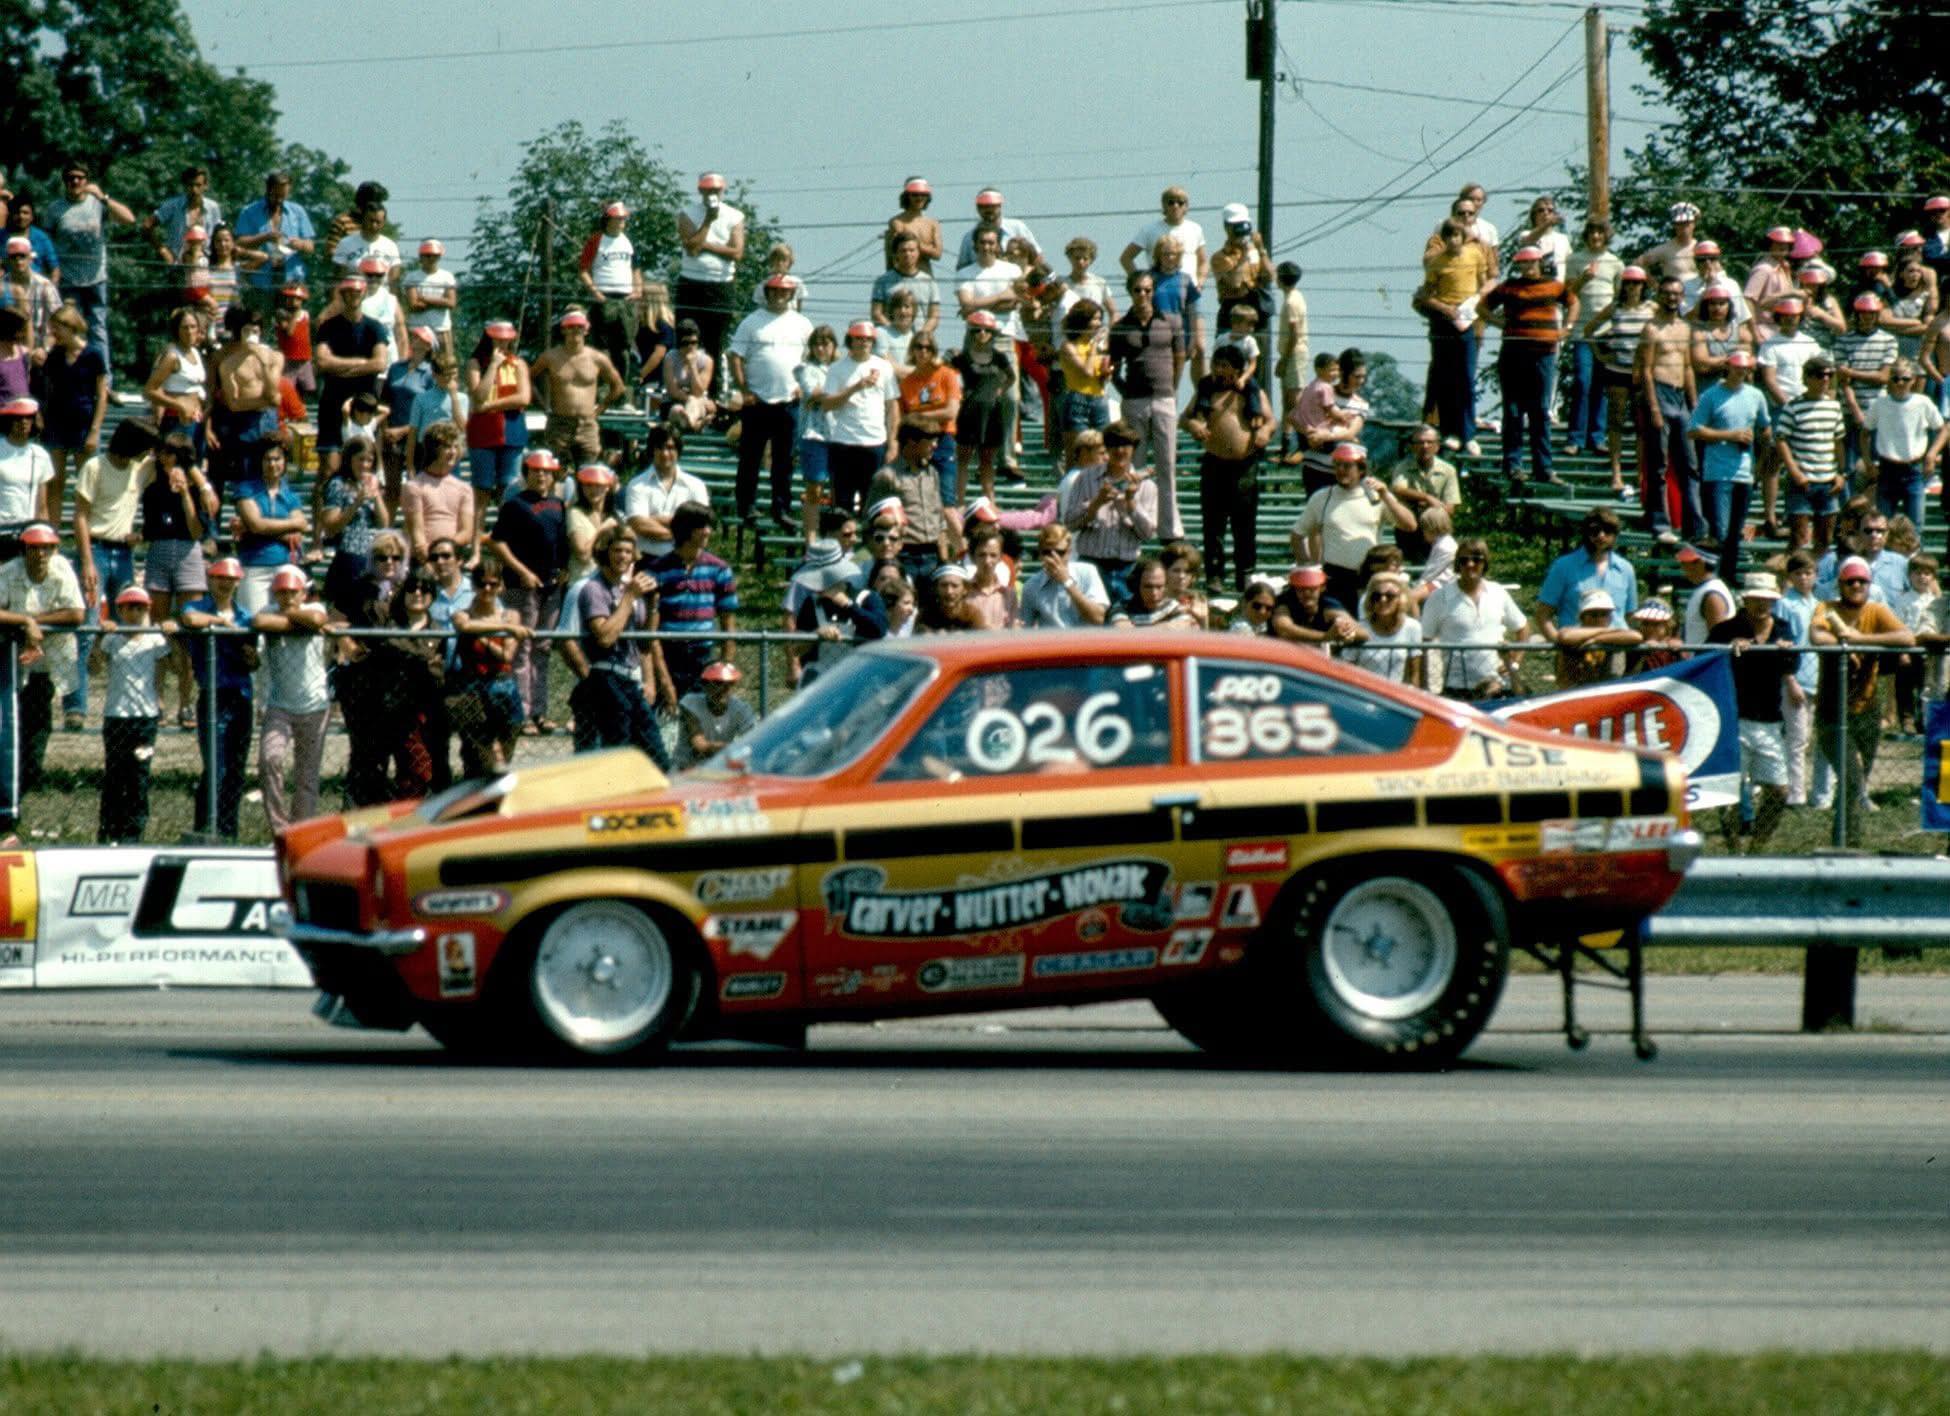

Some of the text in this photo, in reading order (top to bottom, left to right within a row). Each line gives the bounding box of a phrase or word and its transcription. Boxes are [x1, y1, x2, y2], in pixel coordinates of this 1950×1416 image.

[1209, 675, 1281, 701] PRO
[966, 691, 1132, 772] 026
[1206, 703, 1338, 757] 365
[1469, 730, 1567, 767] TSE
[82, 884, 131, 906] MR
[60, 949, 290, 964] HI-PERFORMANCE
